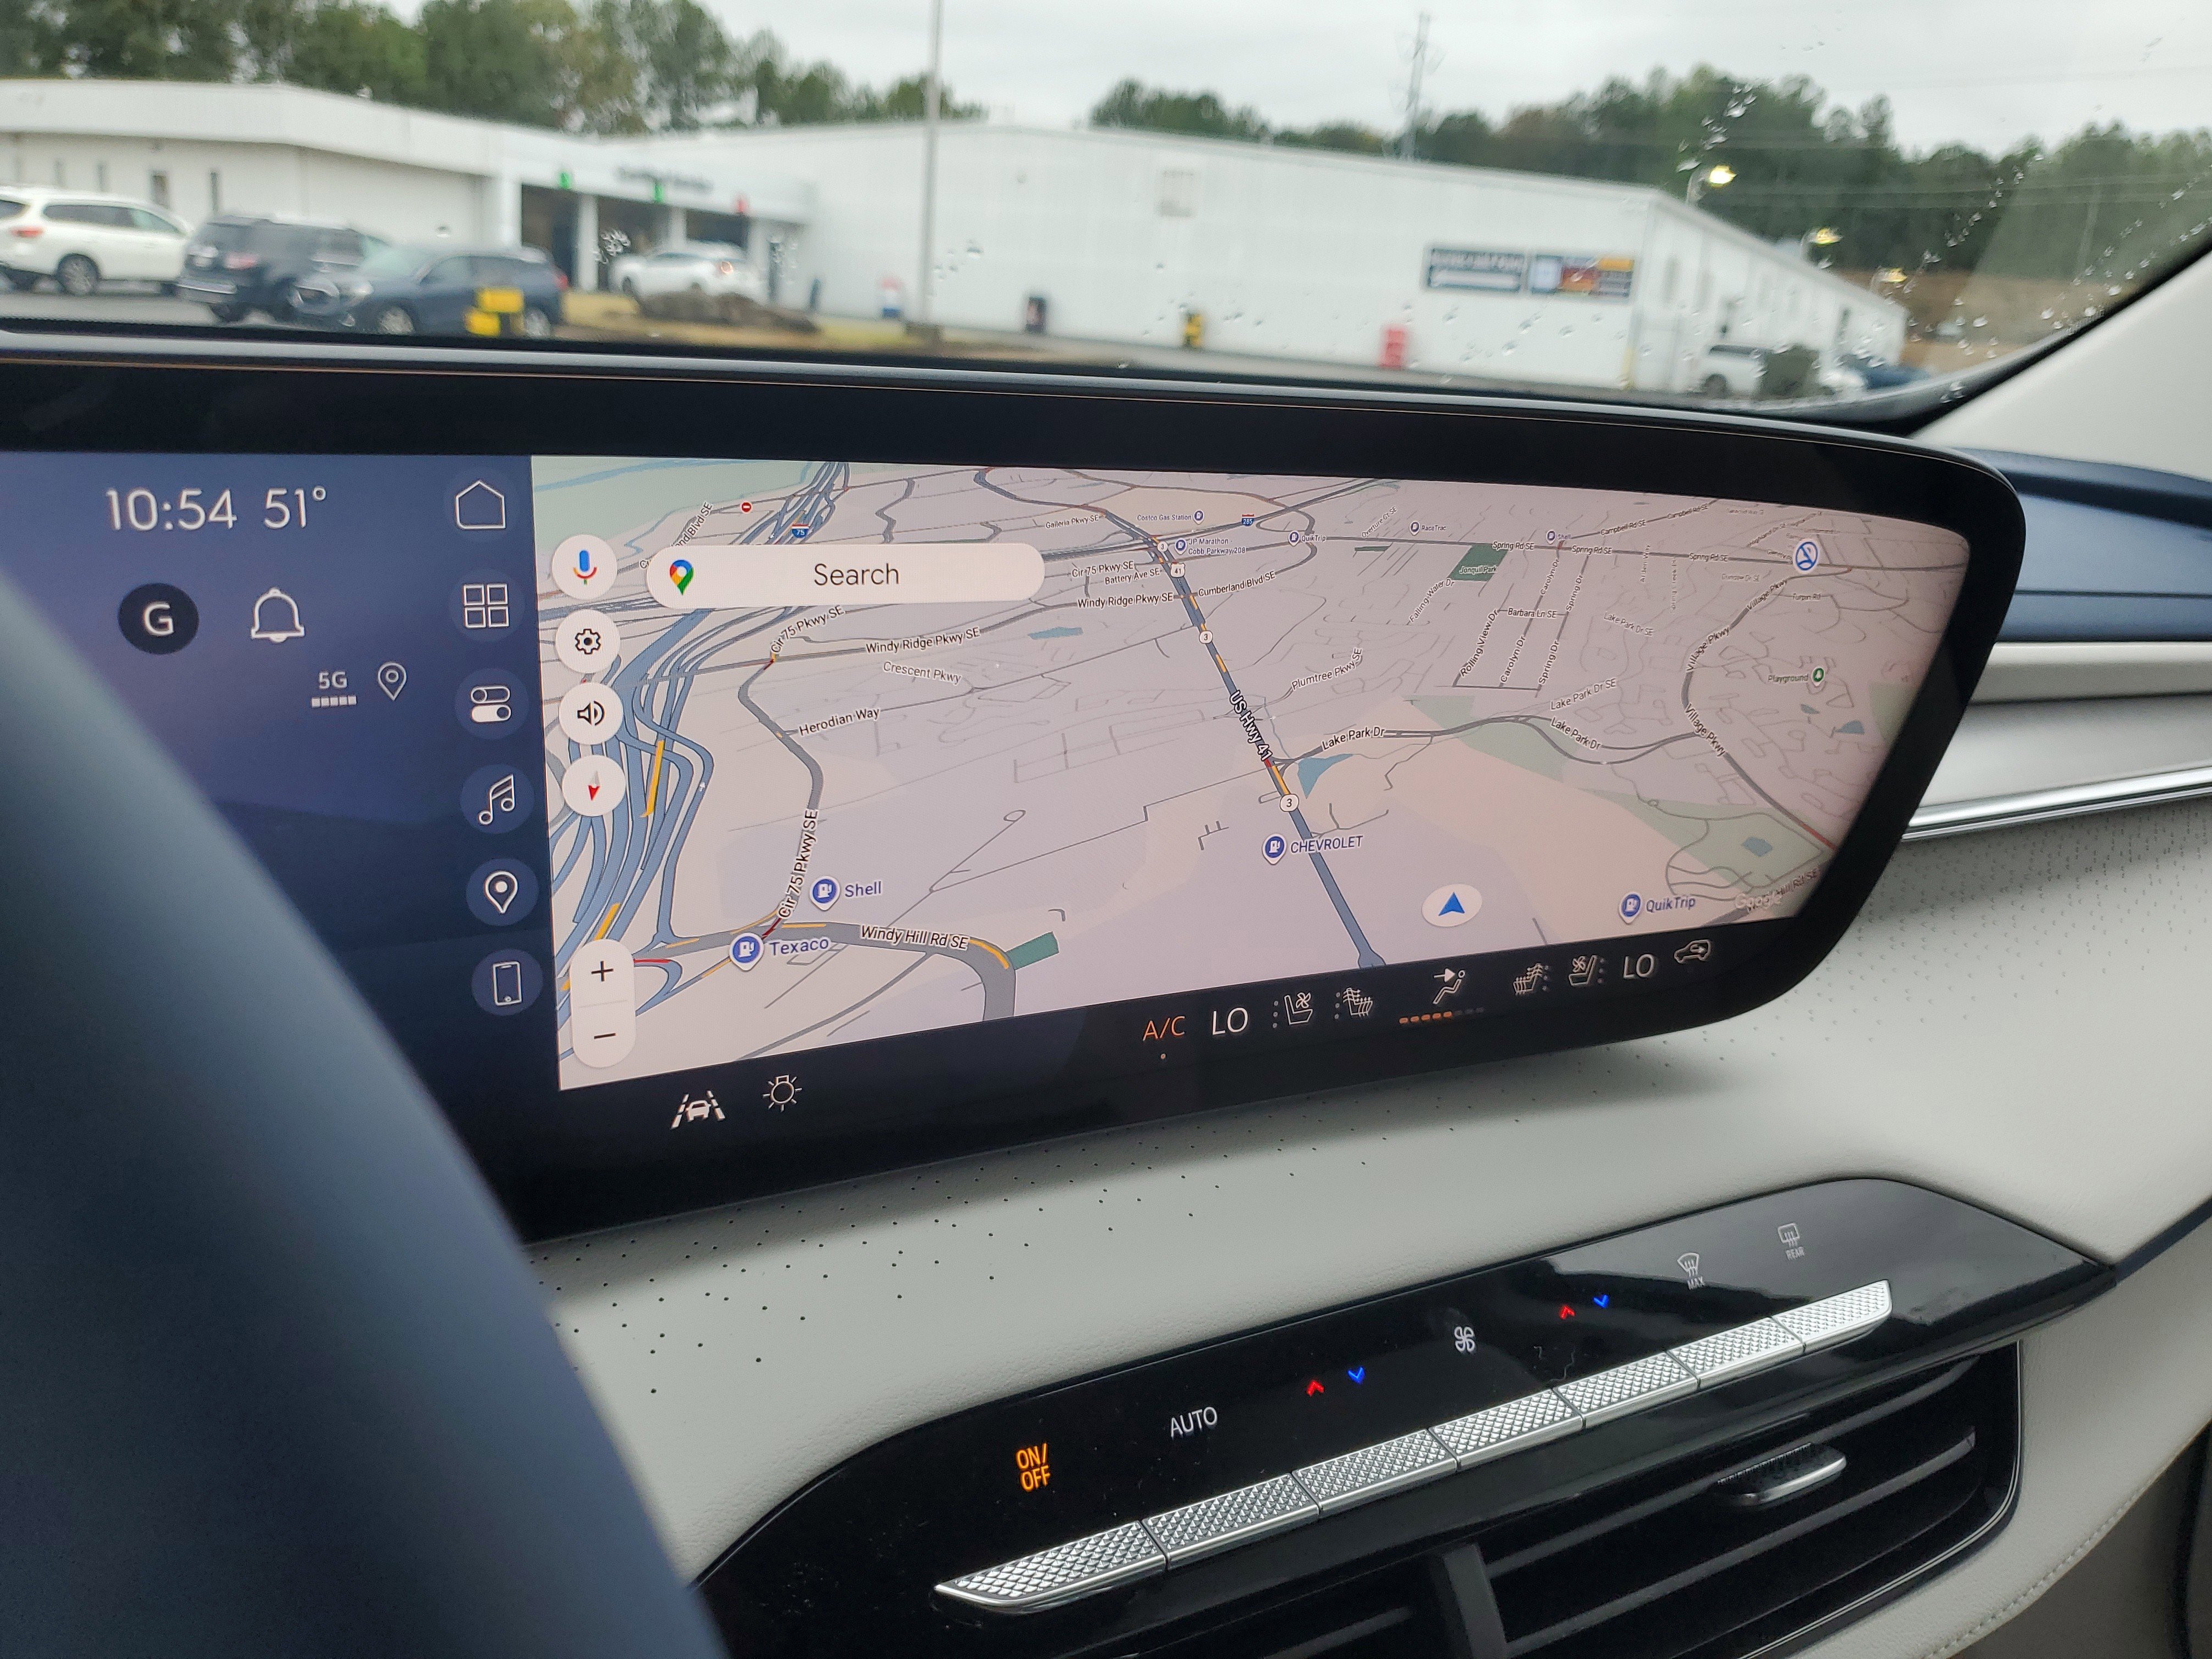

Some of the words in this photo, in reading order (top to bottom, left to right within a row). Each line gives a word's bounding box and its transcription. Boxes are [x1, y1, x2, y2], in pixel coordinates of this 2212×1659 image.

[106, 488, 236, 531] 10:54
[264, 485, 326, 528] 51°
[687, 516, 704, 536] Blvd
[701, 502, 712, 516] SE
[1493, 541, 1515, 551] Spring
[814, 563, 900, 586] Search
[1072, 568, 1084, 577] Cir
[1086, 566, 1096, 574] 75
[1099, 564, 1121, 573] Pkwy
[1123, 561, 1134, 569] SE
[1105, 574, 1132, 584] Battery
[1133, 572, 1148, 580] Ave
[1541, 568, 1555, 595] Carolyn
[1552, 558, 1560, 568] Dr
[1199, 580, 1245, 597] Cumberland
[1246, 576, 1263, 587] Blvd
[1263, 571, 1275, 581] SE
[1566, 586, 1581, 611] Spring
[1575, 574, 1583, 585] Dr
[1077, 599, 1106, 608] Windy
[1108, 597, 1133, 607] Ridge
[1136, 595, 1160, 605] Pkwy
[1161, 592, 1173, 601] SE
[1409, 598, 1429, 624] Falling
[1427, 581, 1444, 599] Water
[1445, 579, 1454, 587] Dr
[1508, 608, 1535, 617] Barbara
[144, 601, 173, 636] G
[771, 635, 785, 653] Cir
[782, 626, 796, 640] 75
[797, 613, 828, 632] Pkwy
[827, 606, 844, 619] SE
[866, 641, 900, 654] Windy
[902, 637, 933, 652] Ridge
[935, 632, 964, 647] Pkwy
[964, 627, 980, 639] SE
[1460, 647, 1484, 677] Rolling
[1478, 624, 1492, 648] View
[1488, 609, 1499, 626] Dr
[1688, 642, 1708, 672] Village
[1706, 627, 1730, 645] Pkwy
[1292, 670, 1332, 690] Plumtree
[1334, 661, 1356, 678] Pkwy
[1352, 648, 1362, 661] SE
[1500, 653, 1519, 683] Carolyn
[1516, 636, 1526, 648] Dr
[1538, 653, 1555, 685] Spring
[1549, 640, 1559, 653] Dr
[318, 672, 347, 689] 5G
[883, 662, 931, 678] Crescent
[933, 669, 961, 685] Pkwy
[1768, 674, 1808, 683] Playground
[1551, 696, 1570, 710] Lake
[1572, 689, 1592, 704] Park
[1594, 684, 1605, 695] Dr
[1605, 678, 1616, 688] SE
[799, 713, 854, 736] Herodian
[855, 709, 879, 722] Way
[1229, 690, 1248, 714] US
[1240, 713, 1262, 744] Hwy
[1257, 744, 1272, 761] 41
[1551, 717, 1571, 735] Lake
[1570, 730, 1589, 745] Park
[1589, 740, 1601, 750] Dr
[1686, 704, 1706, 736] Village
[1705, 732, 1725, 756] Pkwy
[1322, 735, 1347, 751] Lake
[1348, 729, 1372, 741] Park
[1373, 727, 1385, 737] Dr
[1286, 798, 1292, 807] 3
[804, 809, 817, 830] SE
[794, 832, 816, 873] Pkwy
[1290, 836, 1363, 854] CHEVROLET
[787, 875, 803, 895] 75
[845, 882, 882, 898] Shell
[778, 894, 794, 918] Cir
[1646, 896, 1695, 911] QuikTrip
[770, 939, 829, 956] Texaco
[861, 926, 902, 945] Windy
[905, 930, 928, 944] Hill
[931, 933, 949, 946] Rd
[951, 936, 968, 950] SE
[1623, 954, 1655, 980] LO
[1142, 1016, 1186, 1042] A/C
[1211, 1007, 1249, 1036] LO
[1786, 1246, 1804, 1261] REAR
[1688, 1276, 1705, 1290] MAX
[1170, 1406, 1218, 1440] AUTO
[1016, 1442, 1048, 1469] ON/
[1020, 1465, 1051, 1492] OFF
